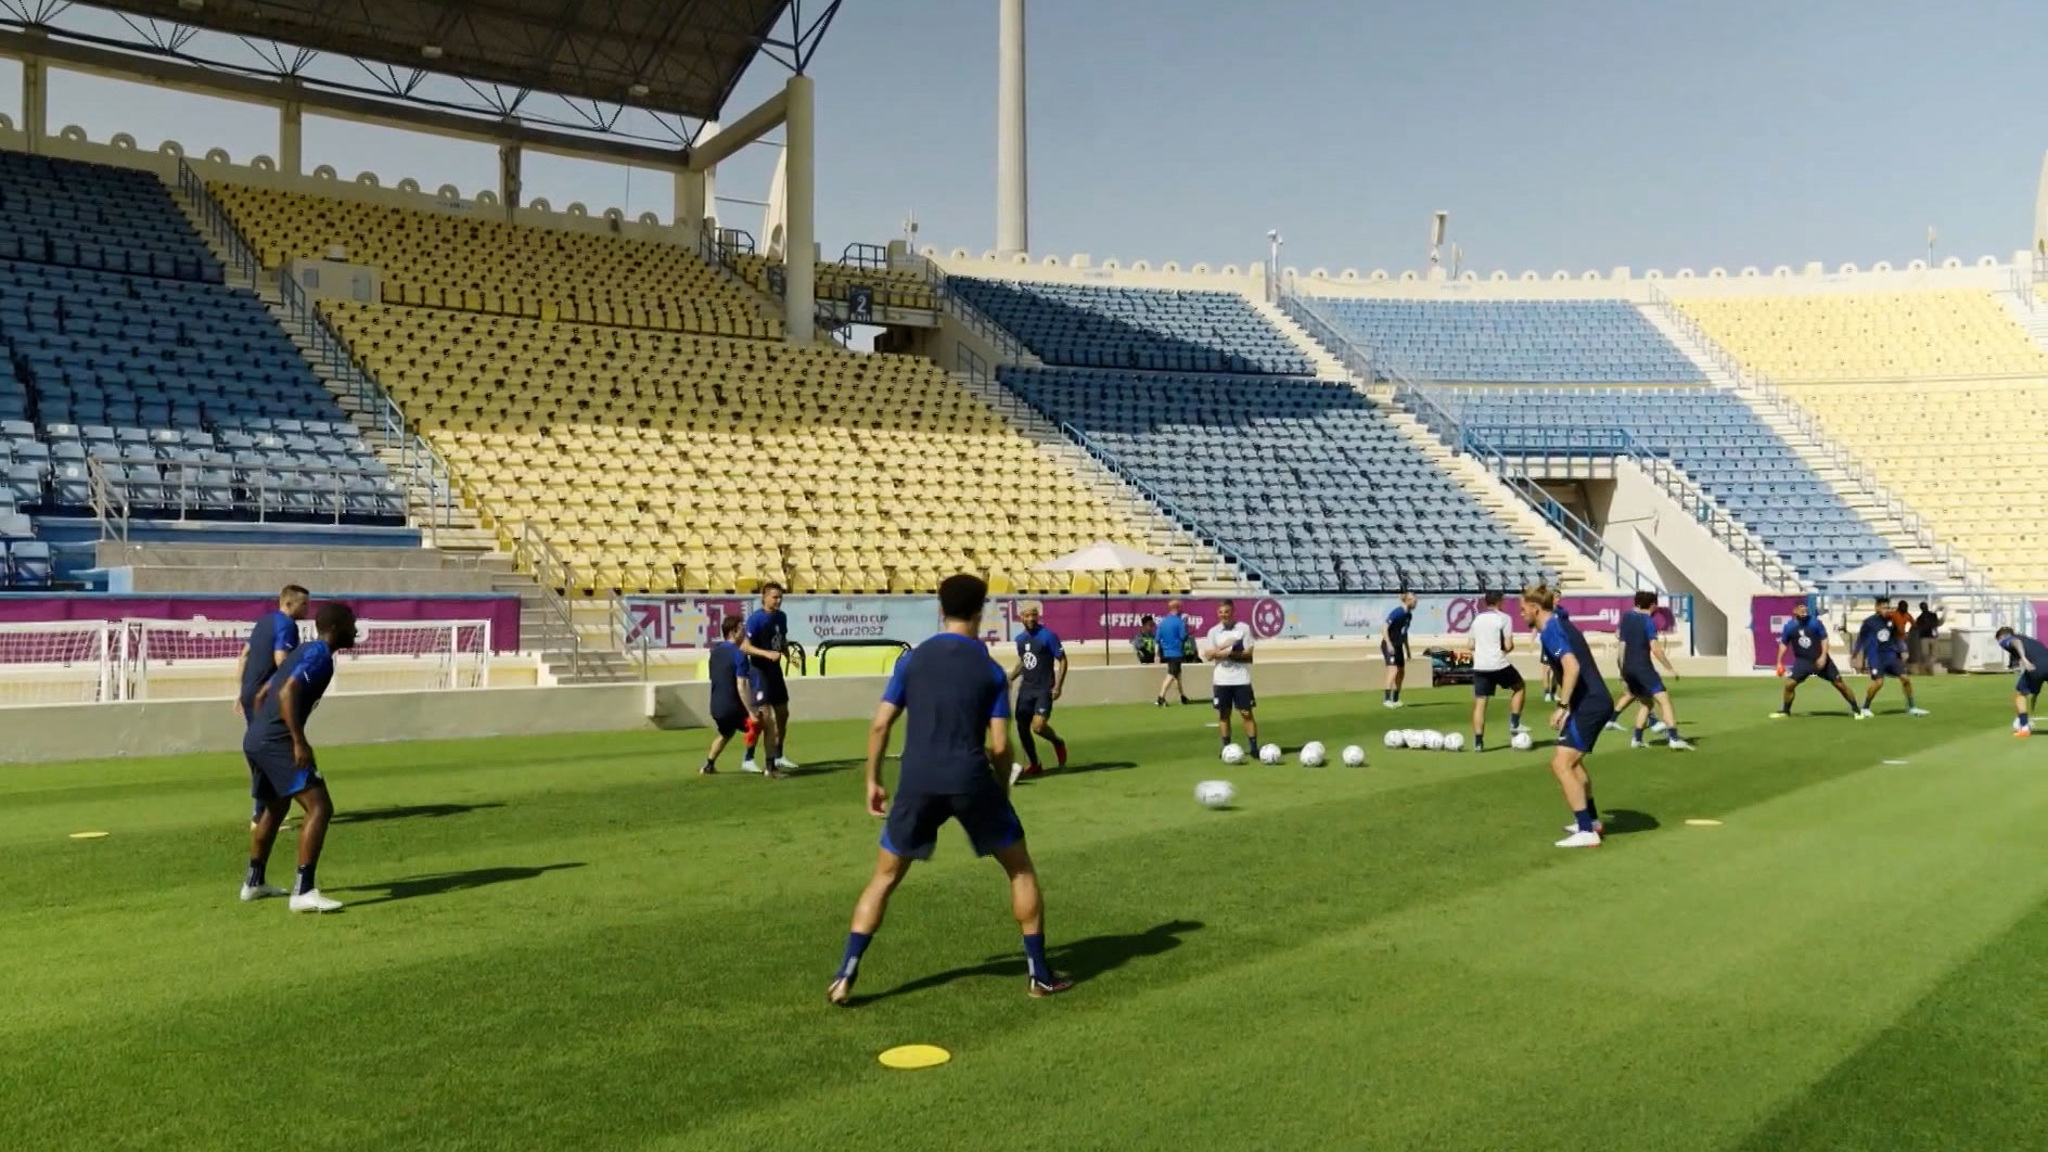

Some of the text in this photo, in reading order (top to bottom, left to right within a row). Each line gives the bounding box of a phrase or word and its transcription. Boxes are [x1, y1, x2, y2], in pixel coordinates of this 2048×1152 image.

[857, 295, 867, 313] 2
[808, 615, 889, 623] FIFA WORLD CUP
